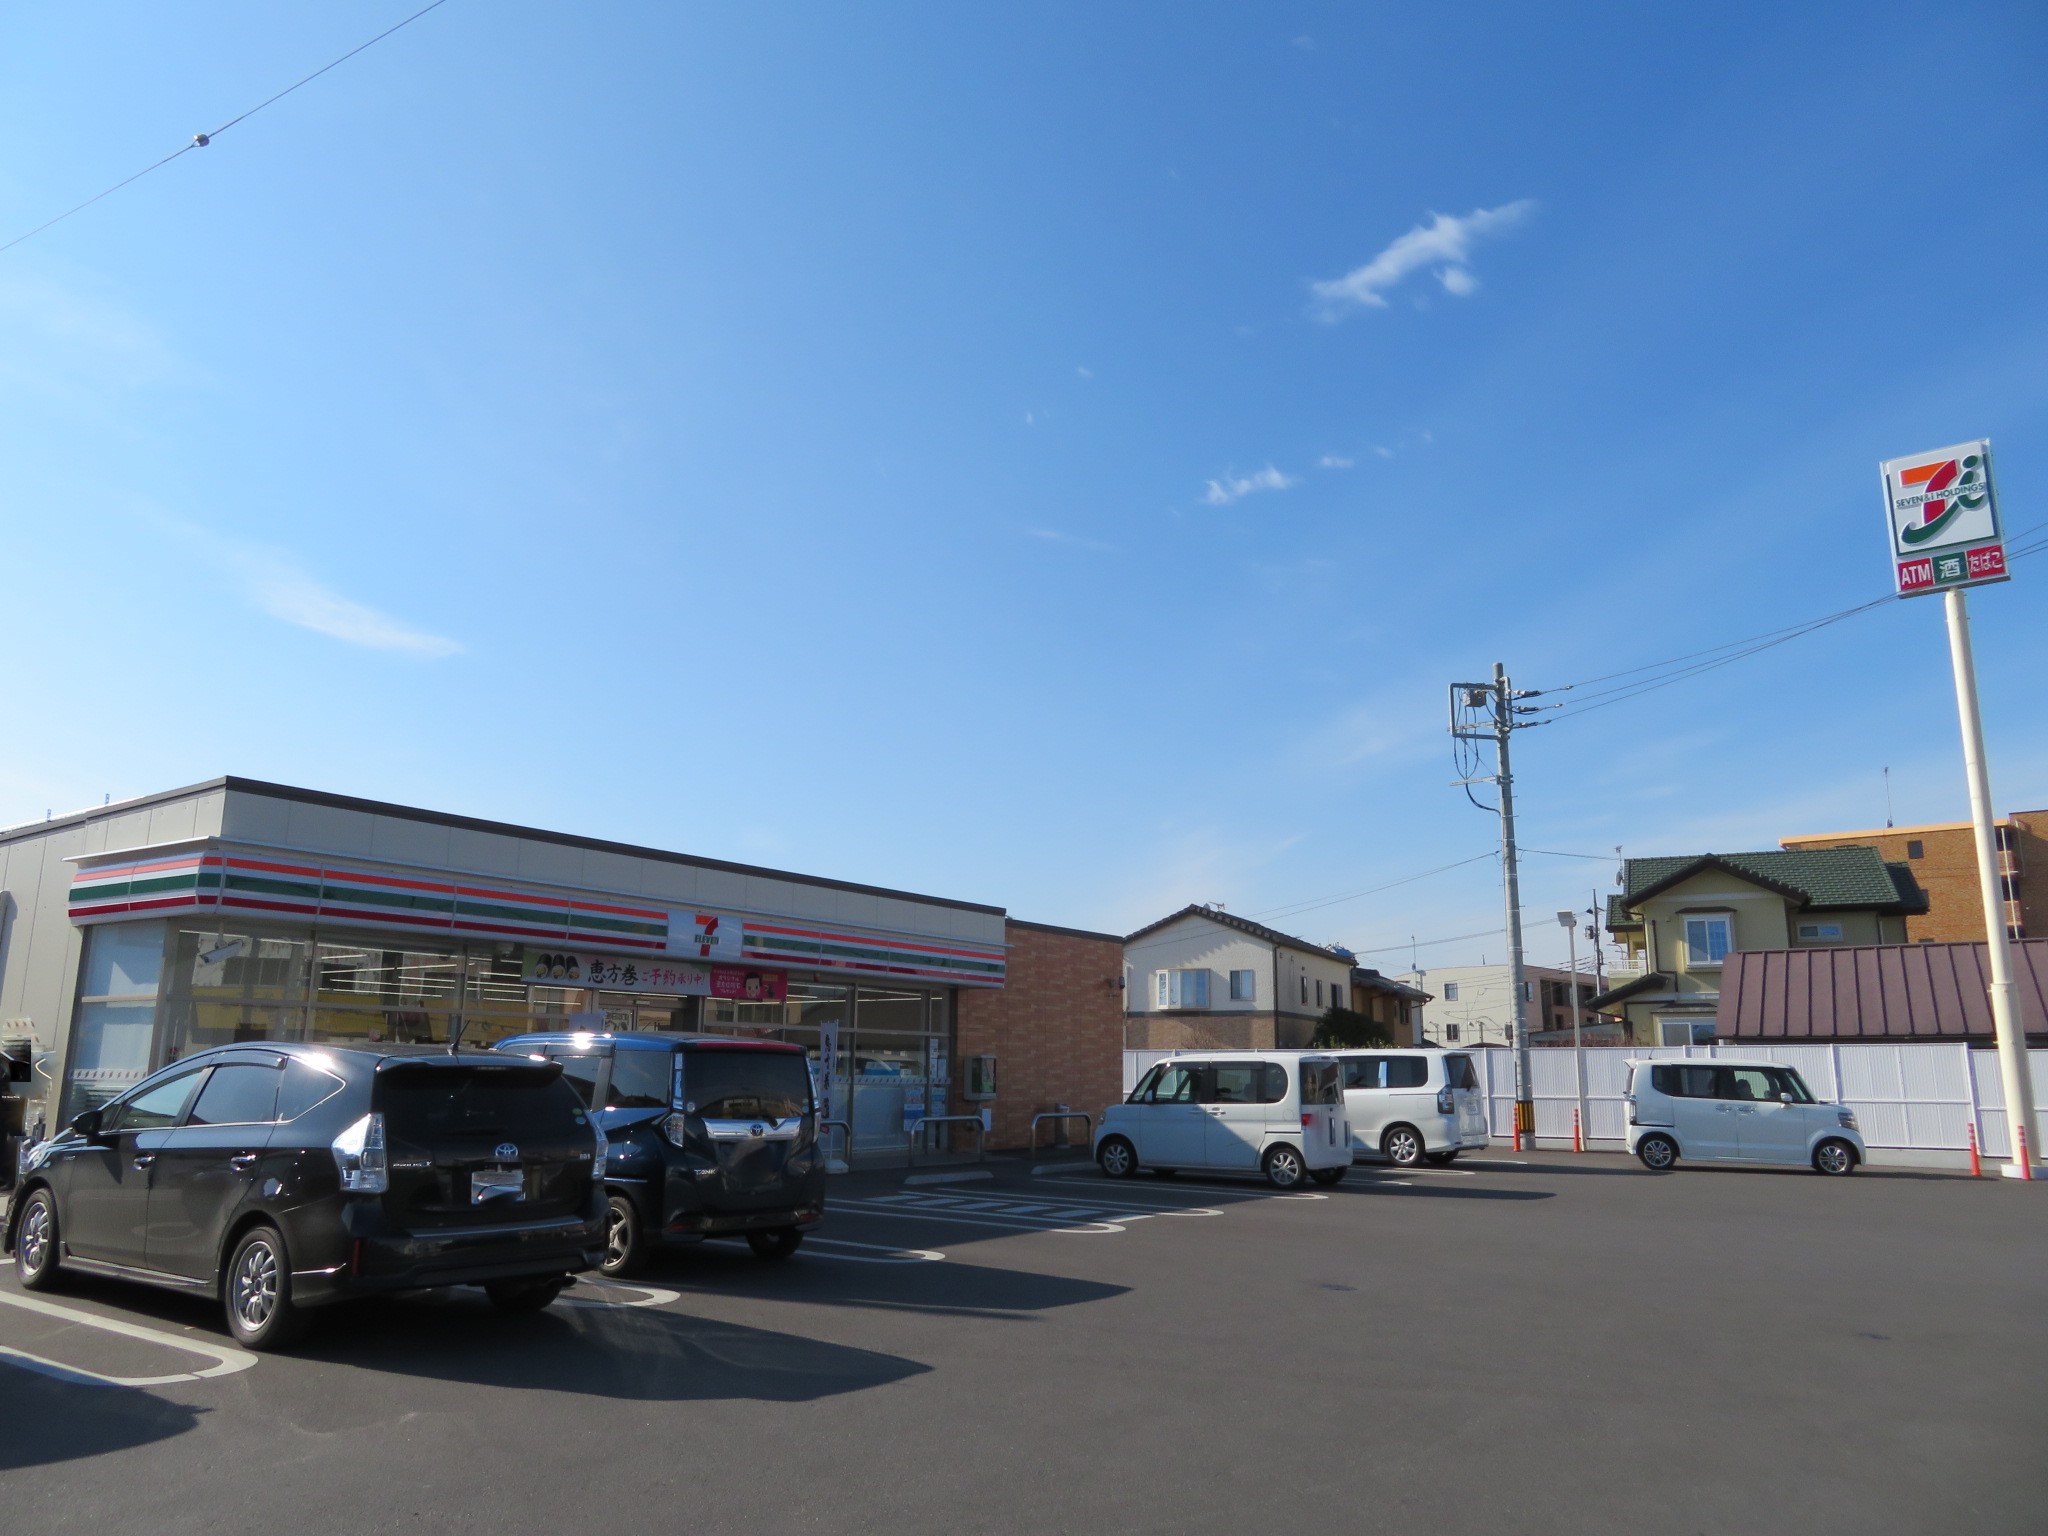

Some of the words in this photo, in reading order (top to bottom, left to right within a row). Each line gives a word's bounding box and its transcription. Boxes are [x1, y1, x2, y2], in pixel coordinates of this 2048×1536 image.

[1936, 482, 1985, 499] HOLDINGS
[1939, 558, 1960, 578] 酒
[1969, 552, 2003, 573] たばこ
[1901, 563, 1931, 586] ATM
[587, 959, 639, 986] 恵方巻
